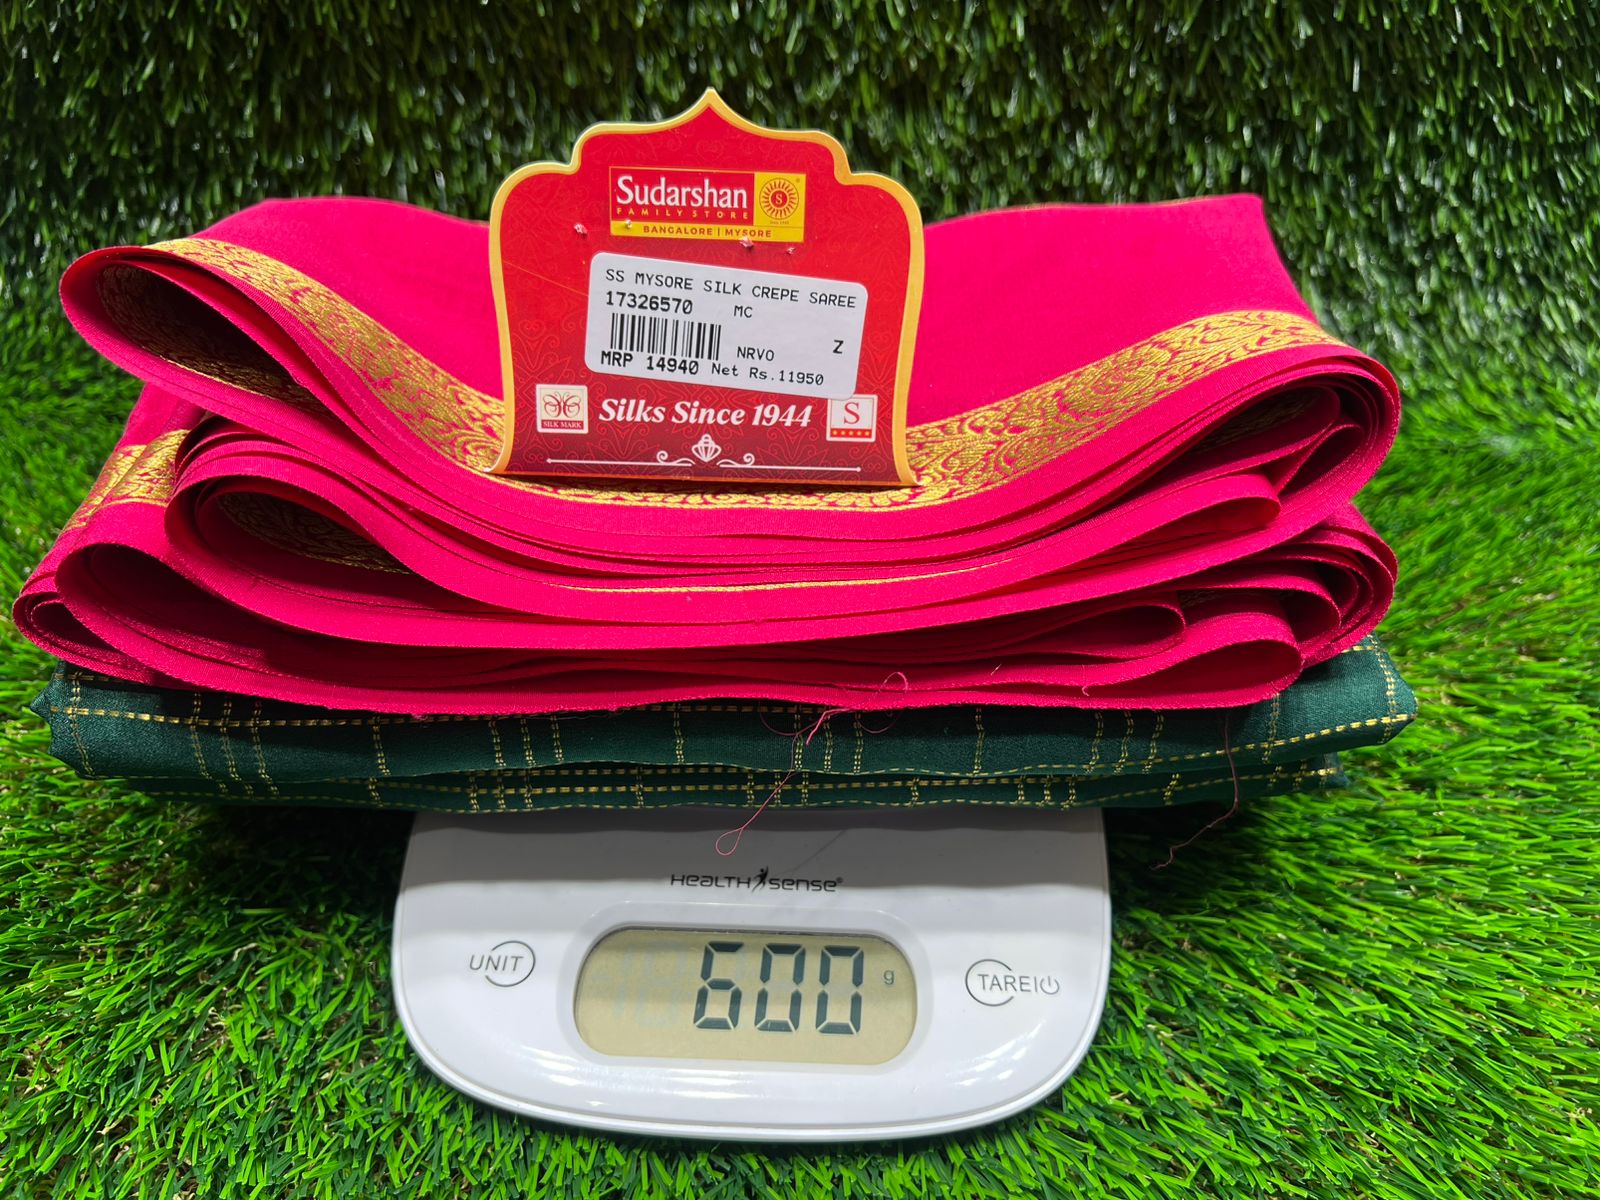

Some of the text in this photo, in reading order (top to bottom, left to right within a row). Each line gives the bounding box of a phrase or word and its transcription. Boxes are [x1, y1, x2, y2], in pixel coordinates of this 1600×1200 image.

[616, 175, 747, 208] Sudarshan
[617, 207, 748, 220] FAMILY STORE
[643, 225, 771, 238] BANGALORE MYSORE
[606, 269, 856, 308] SS MYSORE SILK CREPE SAREE
[605, 291, 693, 315] 17326570
[734, 305, 753, 318] MC
[737, 347, 775, 361] NRVO
[833, 340, 844, 354] Z
[601, 351, 824, 385] MRP 14940 Net Rs.11950
[598, 398, 812, 428] Silks Since 1944
[843, 402, 861, 425] S
[561, 421, 582, 429] MARK
[468, 954, 524, 972] UNIT
[693, 939, 895, 1034] 600 g
